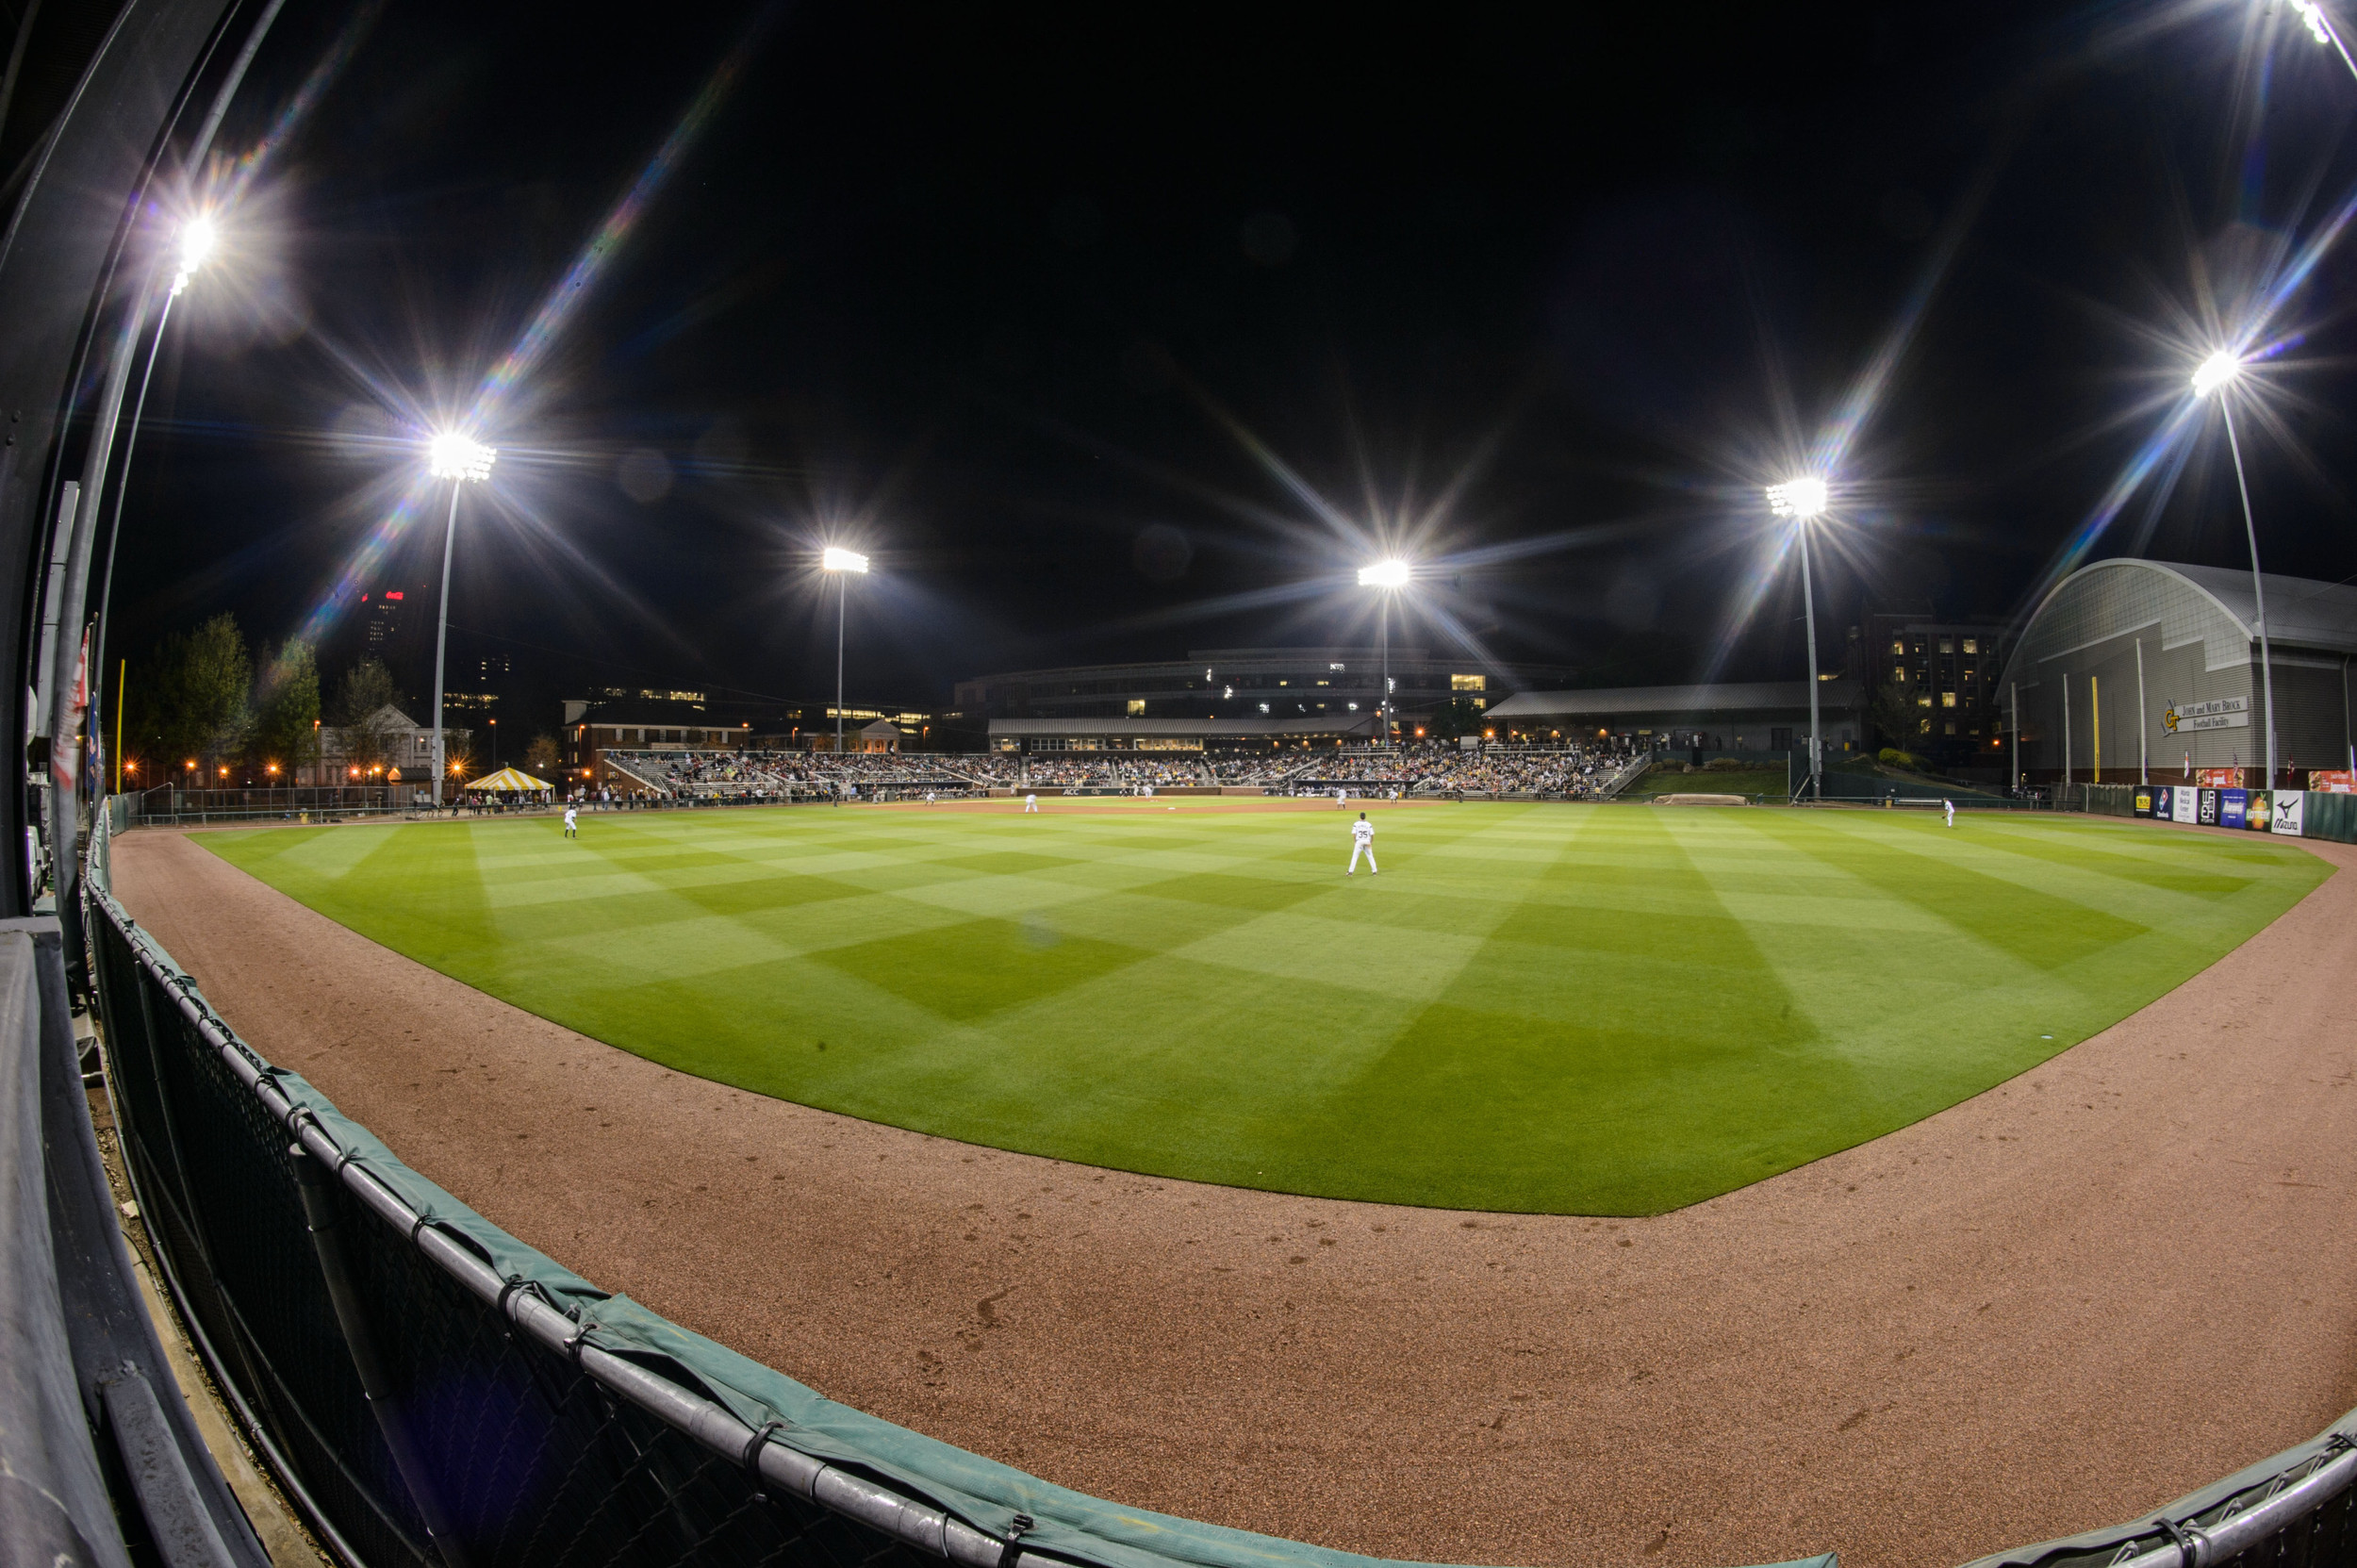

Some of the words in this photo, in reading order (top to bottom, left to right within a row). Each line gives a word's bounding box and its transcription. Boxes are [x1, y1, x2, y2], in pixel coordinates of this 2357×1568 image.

[2183, 705, 2195, 717] JOHN
[2196, 704, 2204, 714] and
[2205, 701, 2220, 714] MARY
[2222, 700, 2240, 712] BROCK
[2194, 718, 2211, 729] Football
[2212, 716, 2229, 729] Facility
[2248, 810, 2270, 820] LOTTERY
